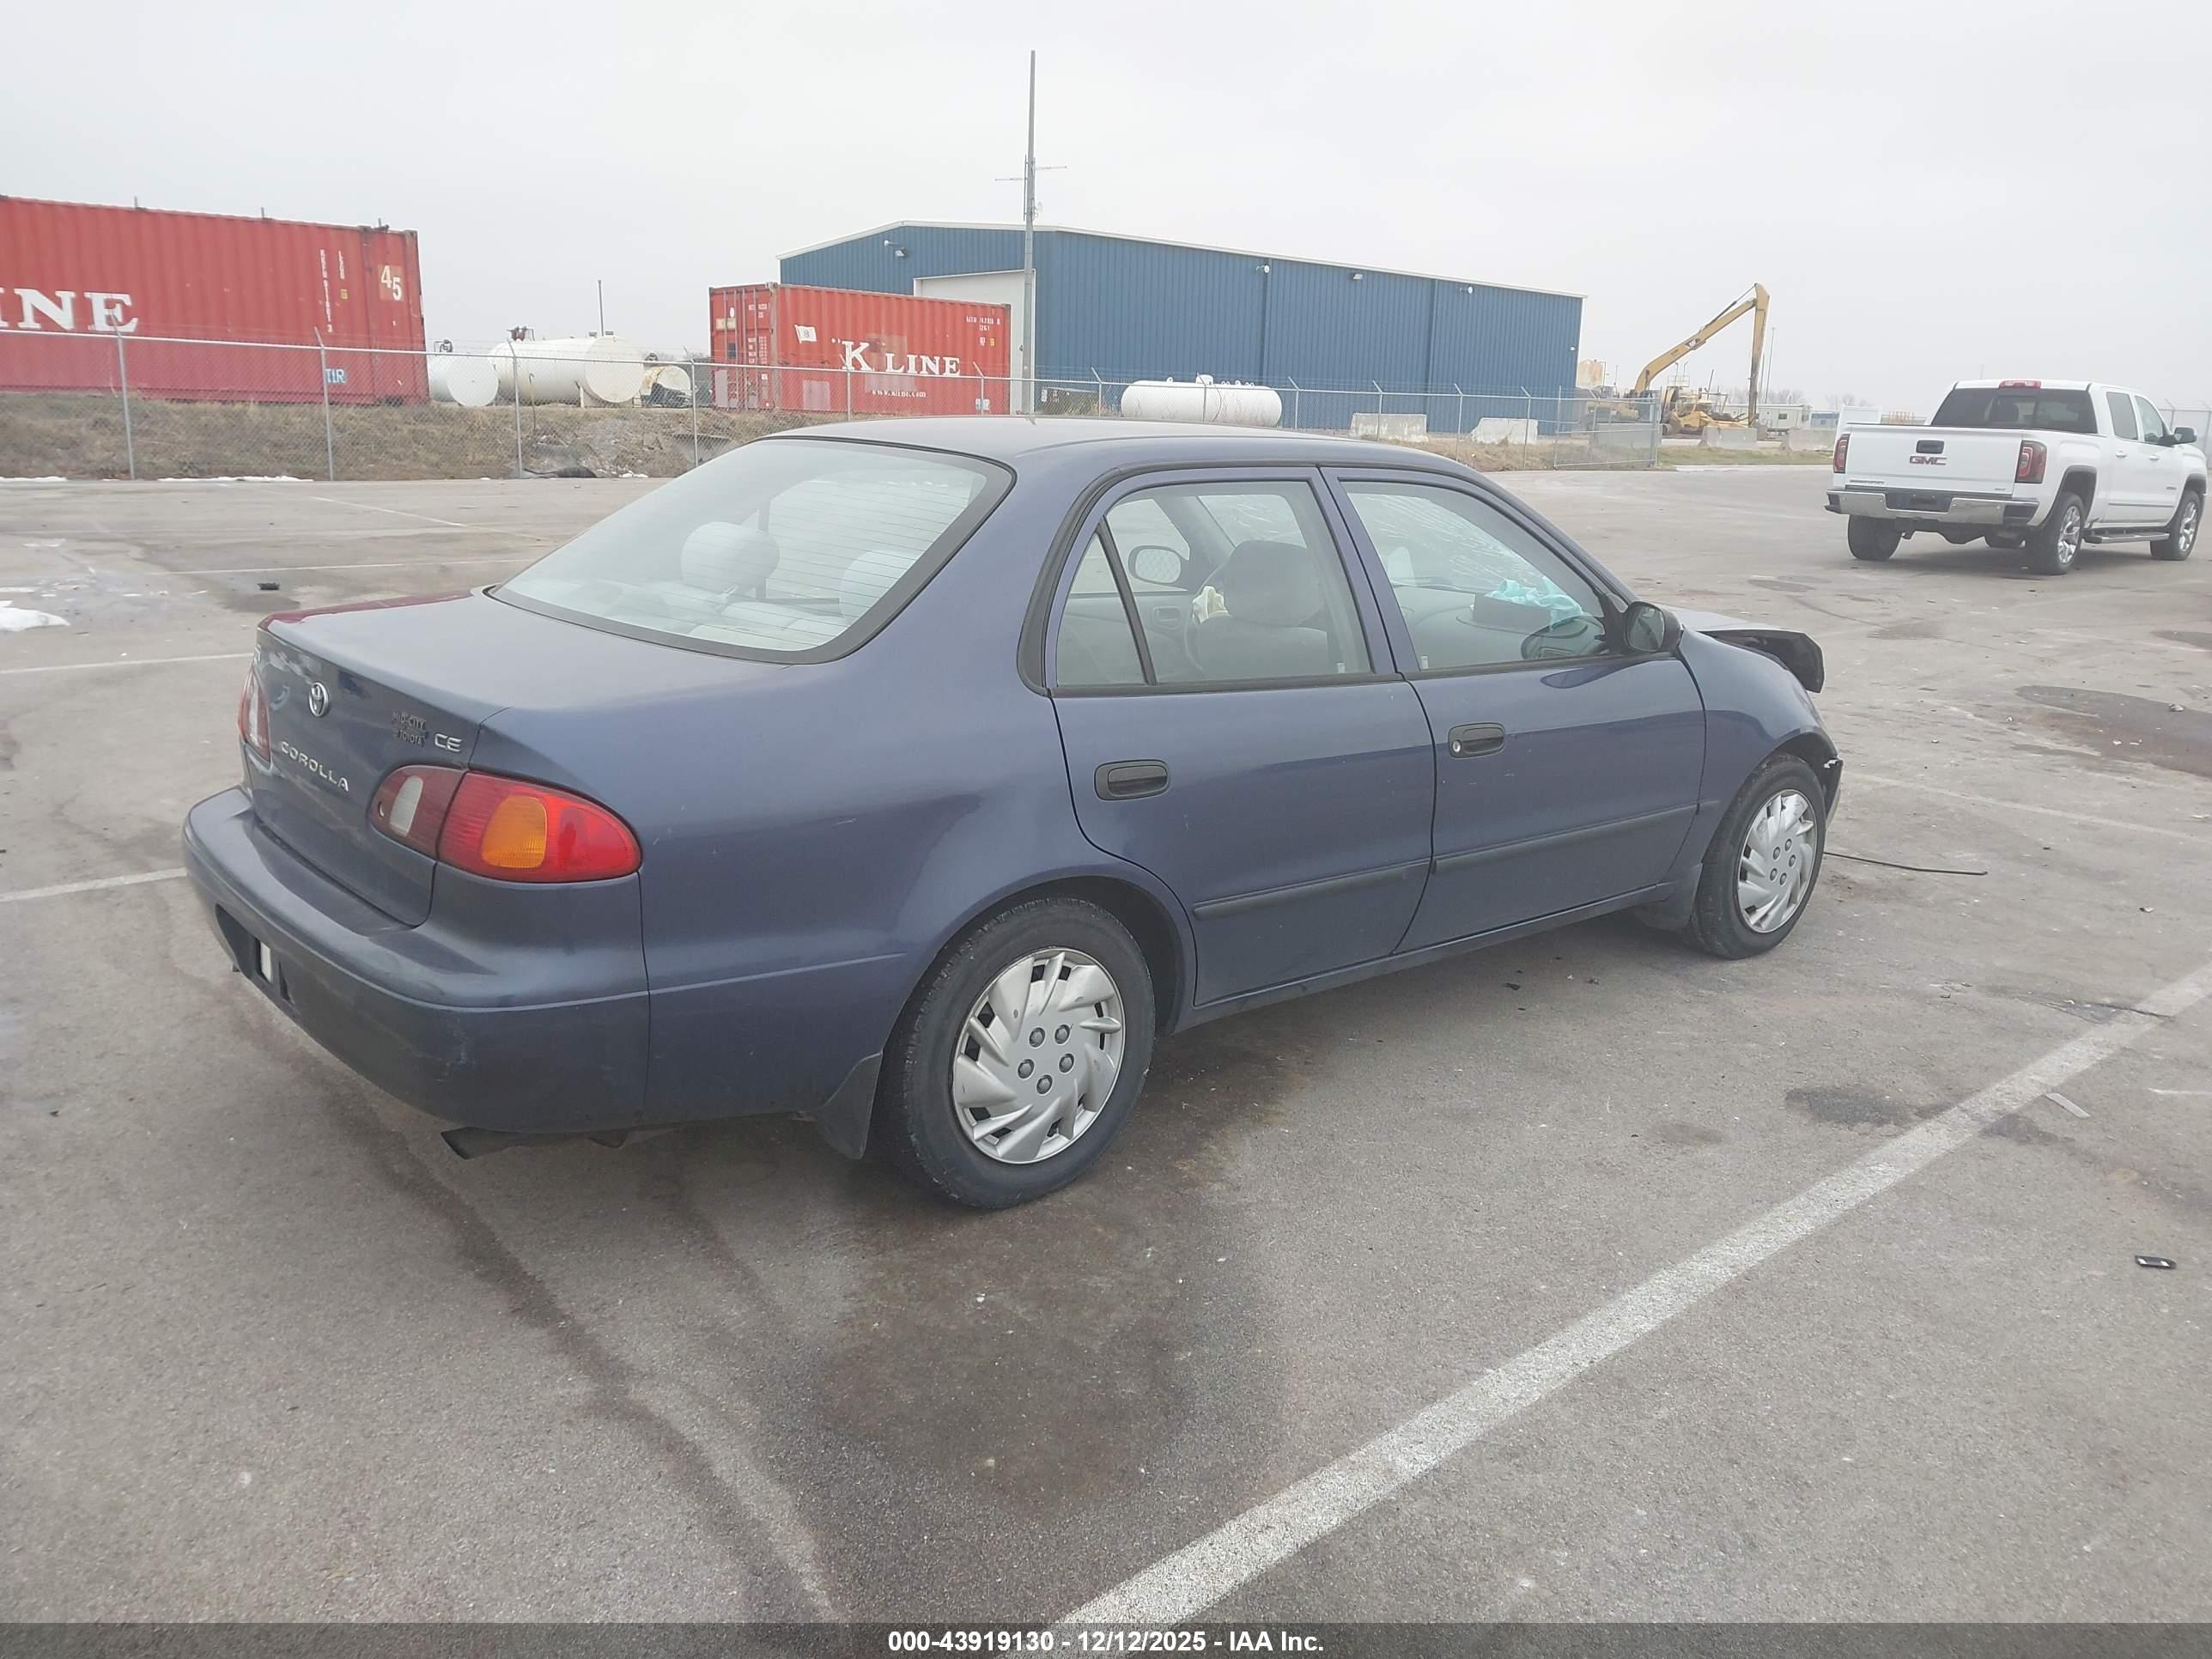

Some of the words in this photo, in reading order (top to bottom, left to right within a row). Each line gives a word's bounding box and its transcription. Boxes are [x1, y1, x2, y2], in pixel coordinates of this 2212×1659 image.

[381, 264, 403, 301] 45
[885, 353, 960, 376] LINE
[325, 368, 346, 383] TIR
[1909, 455, 1948, 466] GMC
[434, 732, 463, 752] CE
[281, 740, 350, 792] COROLLA
